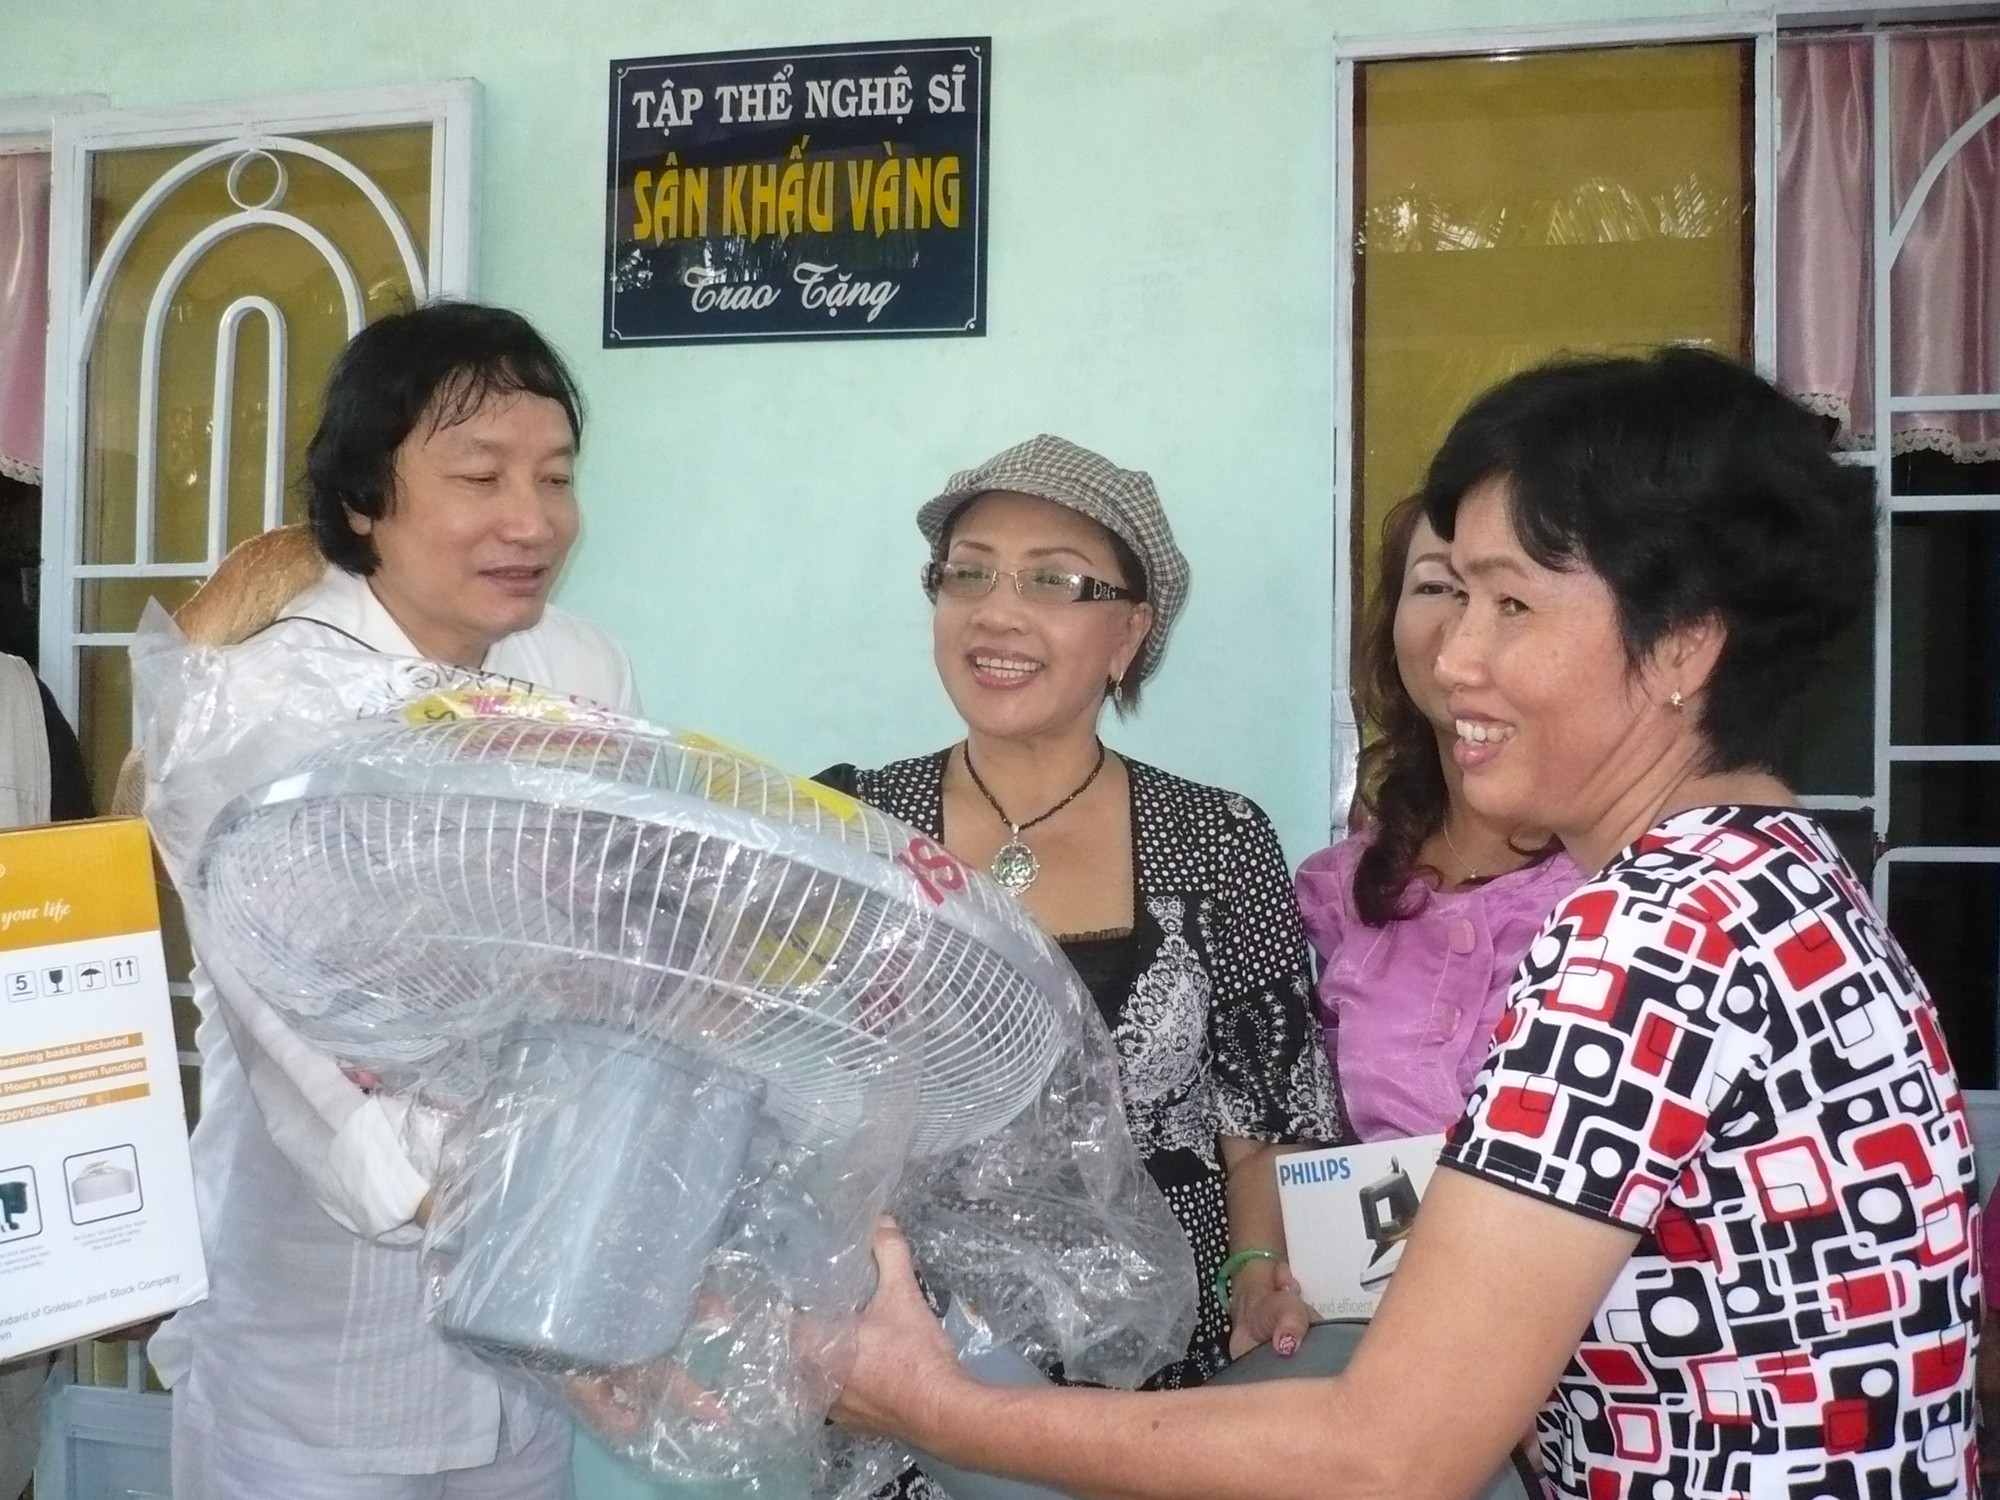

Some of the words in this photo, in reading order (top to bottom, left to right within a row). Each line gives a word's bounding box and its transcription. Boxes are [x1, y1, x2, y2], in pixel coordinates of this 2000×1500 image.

[632, 79, 704, 137] TẬP
[714, 63, 794, 124] THỂ
[805, 65, 913, 125] NGHỆ
[928, 64, 966, 114] SĨ
[633, 151, 709, 247] SÂN
[722, 135, 835, 244] KHẤU
[847, 141, 961, 239] VÀNG
[684, 266, 781, 313] Trao
[793, 262, 900, 323] Tặng
[2, 908, 39, 931] your
[43, 898, 71, 923] life
[15, 974, 28, 991] 5
[46, 1044, 82, 1059] basket
[84, 1036, 129, 1052] included
[5, 1080, 38, 1093] Hours
[41, 1074, 67, 1086] keep
[68, 1069, 98, 1081] warm
[101, 1060, 144, 1075] function
[1279, 1156, 1351, 1186] PHILIPS
[31, 1308, 41, 1318] of
[43, 1298, 83, 1315] Goldsun
[85, 1291, 108, 1305] Joint
[110, 1283, 136, 1298] Stock
[138, 1273, 180, 1291] Company
